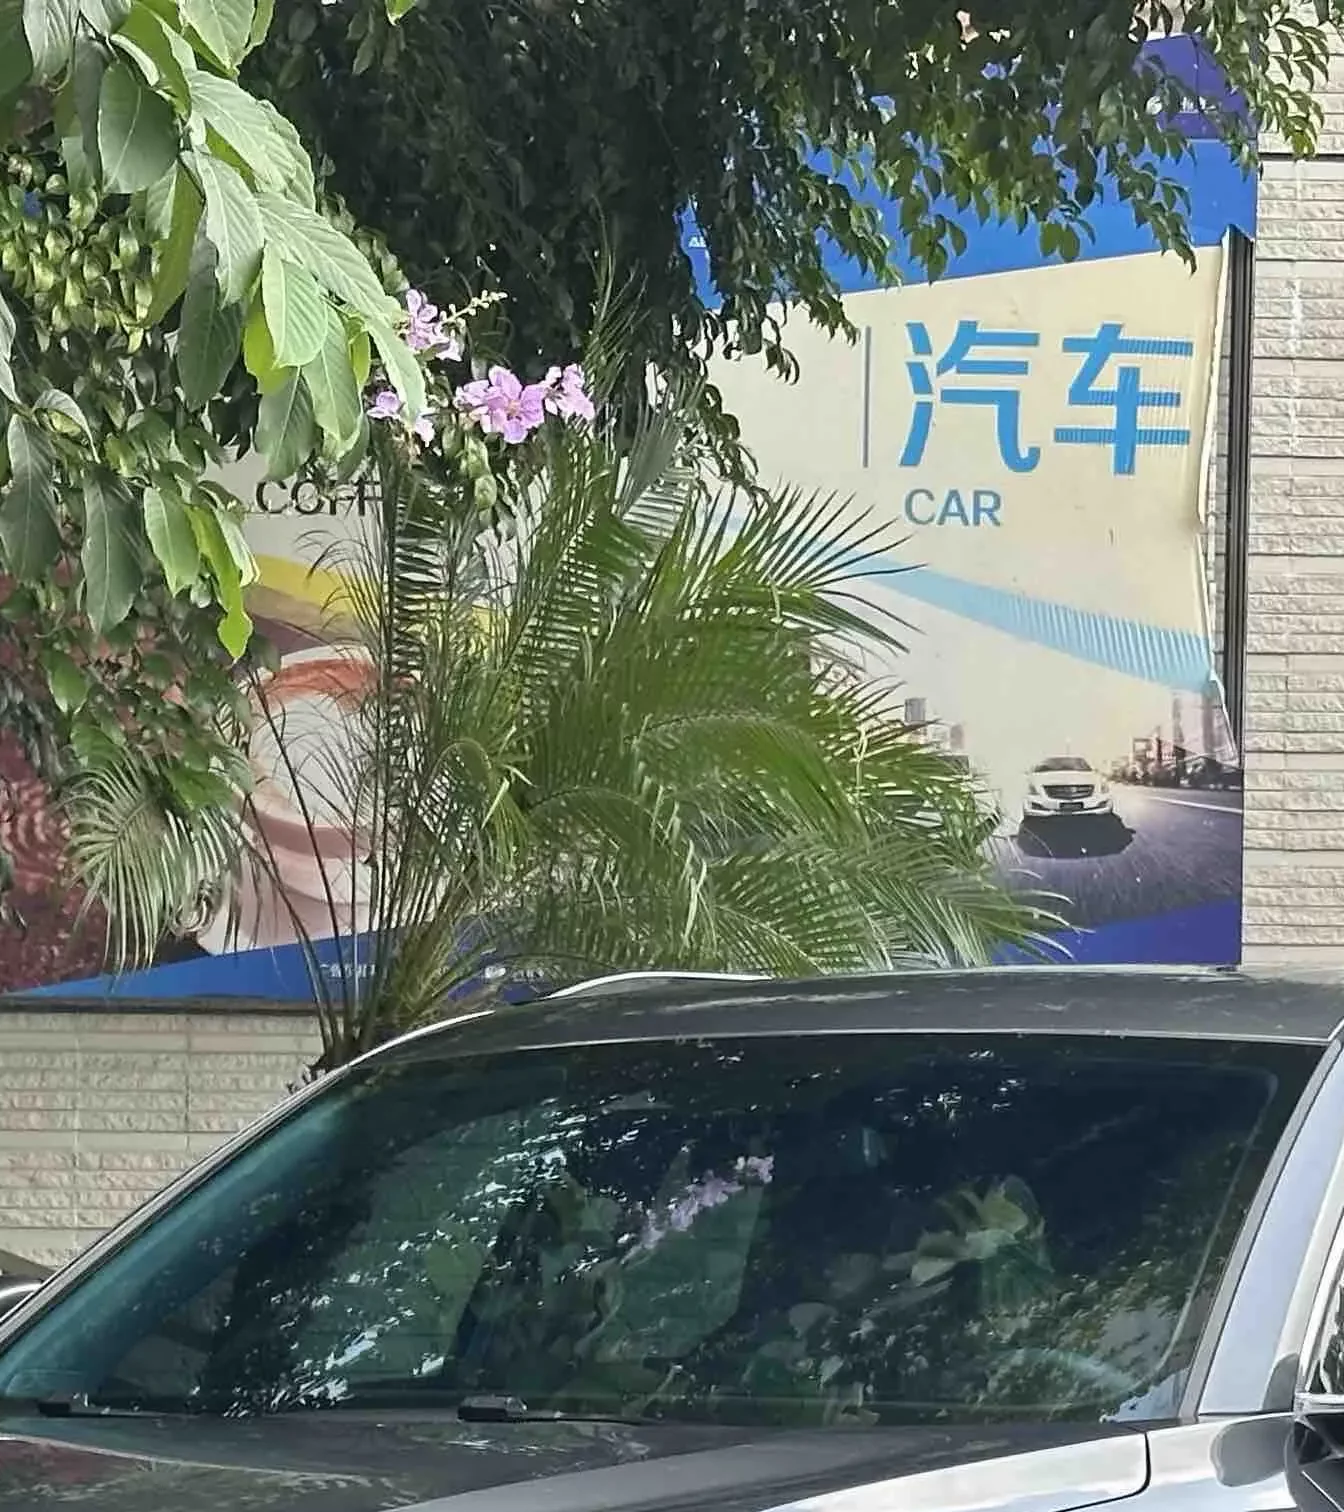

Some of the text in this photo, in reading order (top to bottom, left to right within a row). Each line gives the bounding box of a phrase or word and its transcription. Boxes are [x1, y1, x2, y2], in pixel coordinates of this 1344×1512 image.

[899, 319, 1194, 477] 汽车
[256, 478, 386, 516] COFF
[904, 488, 1002, 527] CAR
